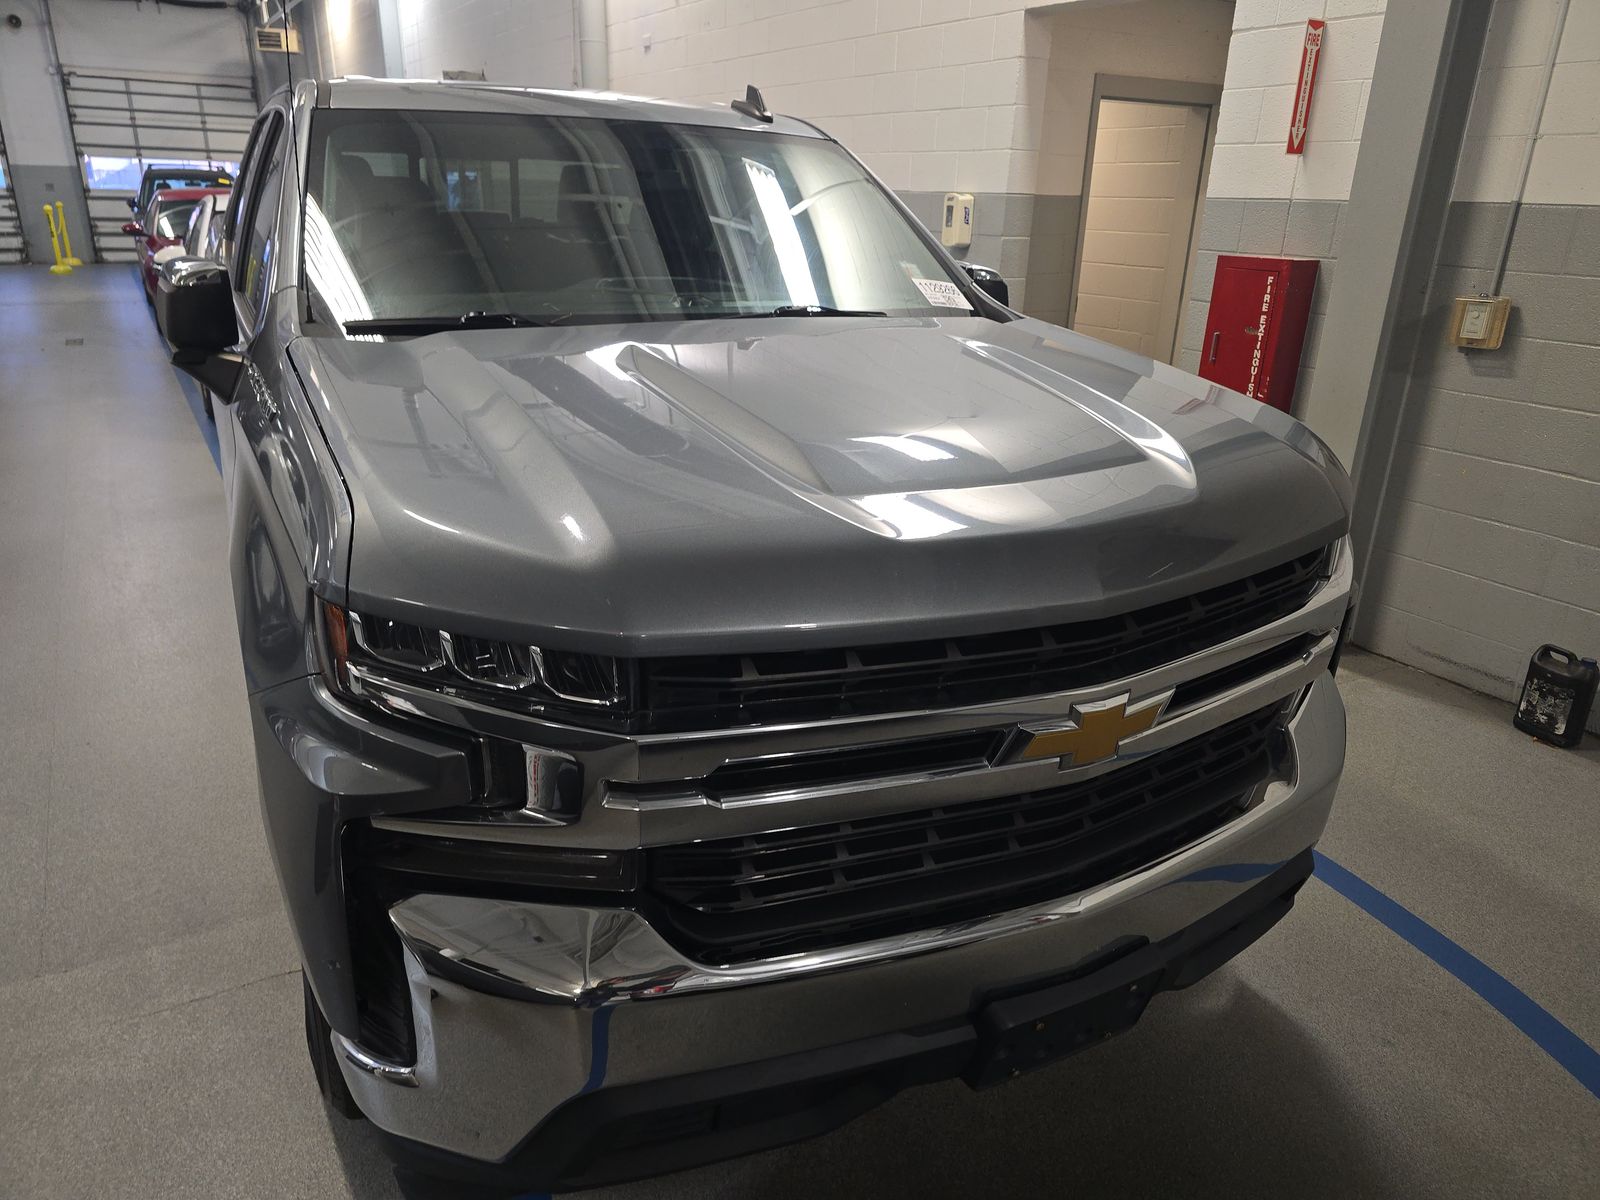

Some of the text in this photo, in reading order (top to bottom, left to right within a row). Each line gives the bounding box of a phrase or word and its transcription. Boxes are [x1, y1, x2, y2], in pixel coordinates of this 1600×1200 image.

[1307, 33, 1321, 47] FIRE
[1295, 48, 1314, 139] EXTINGUISHER
[1262, 276, 1274, 312] FIRE
